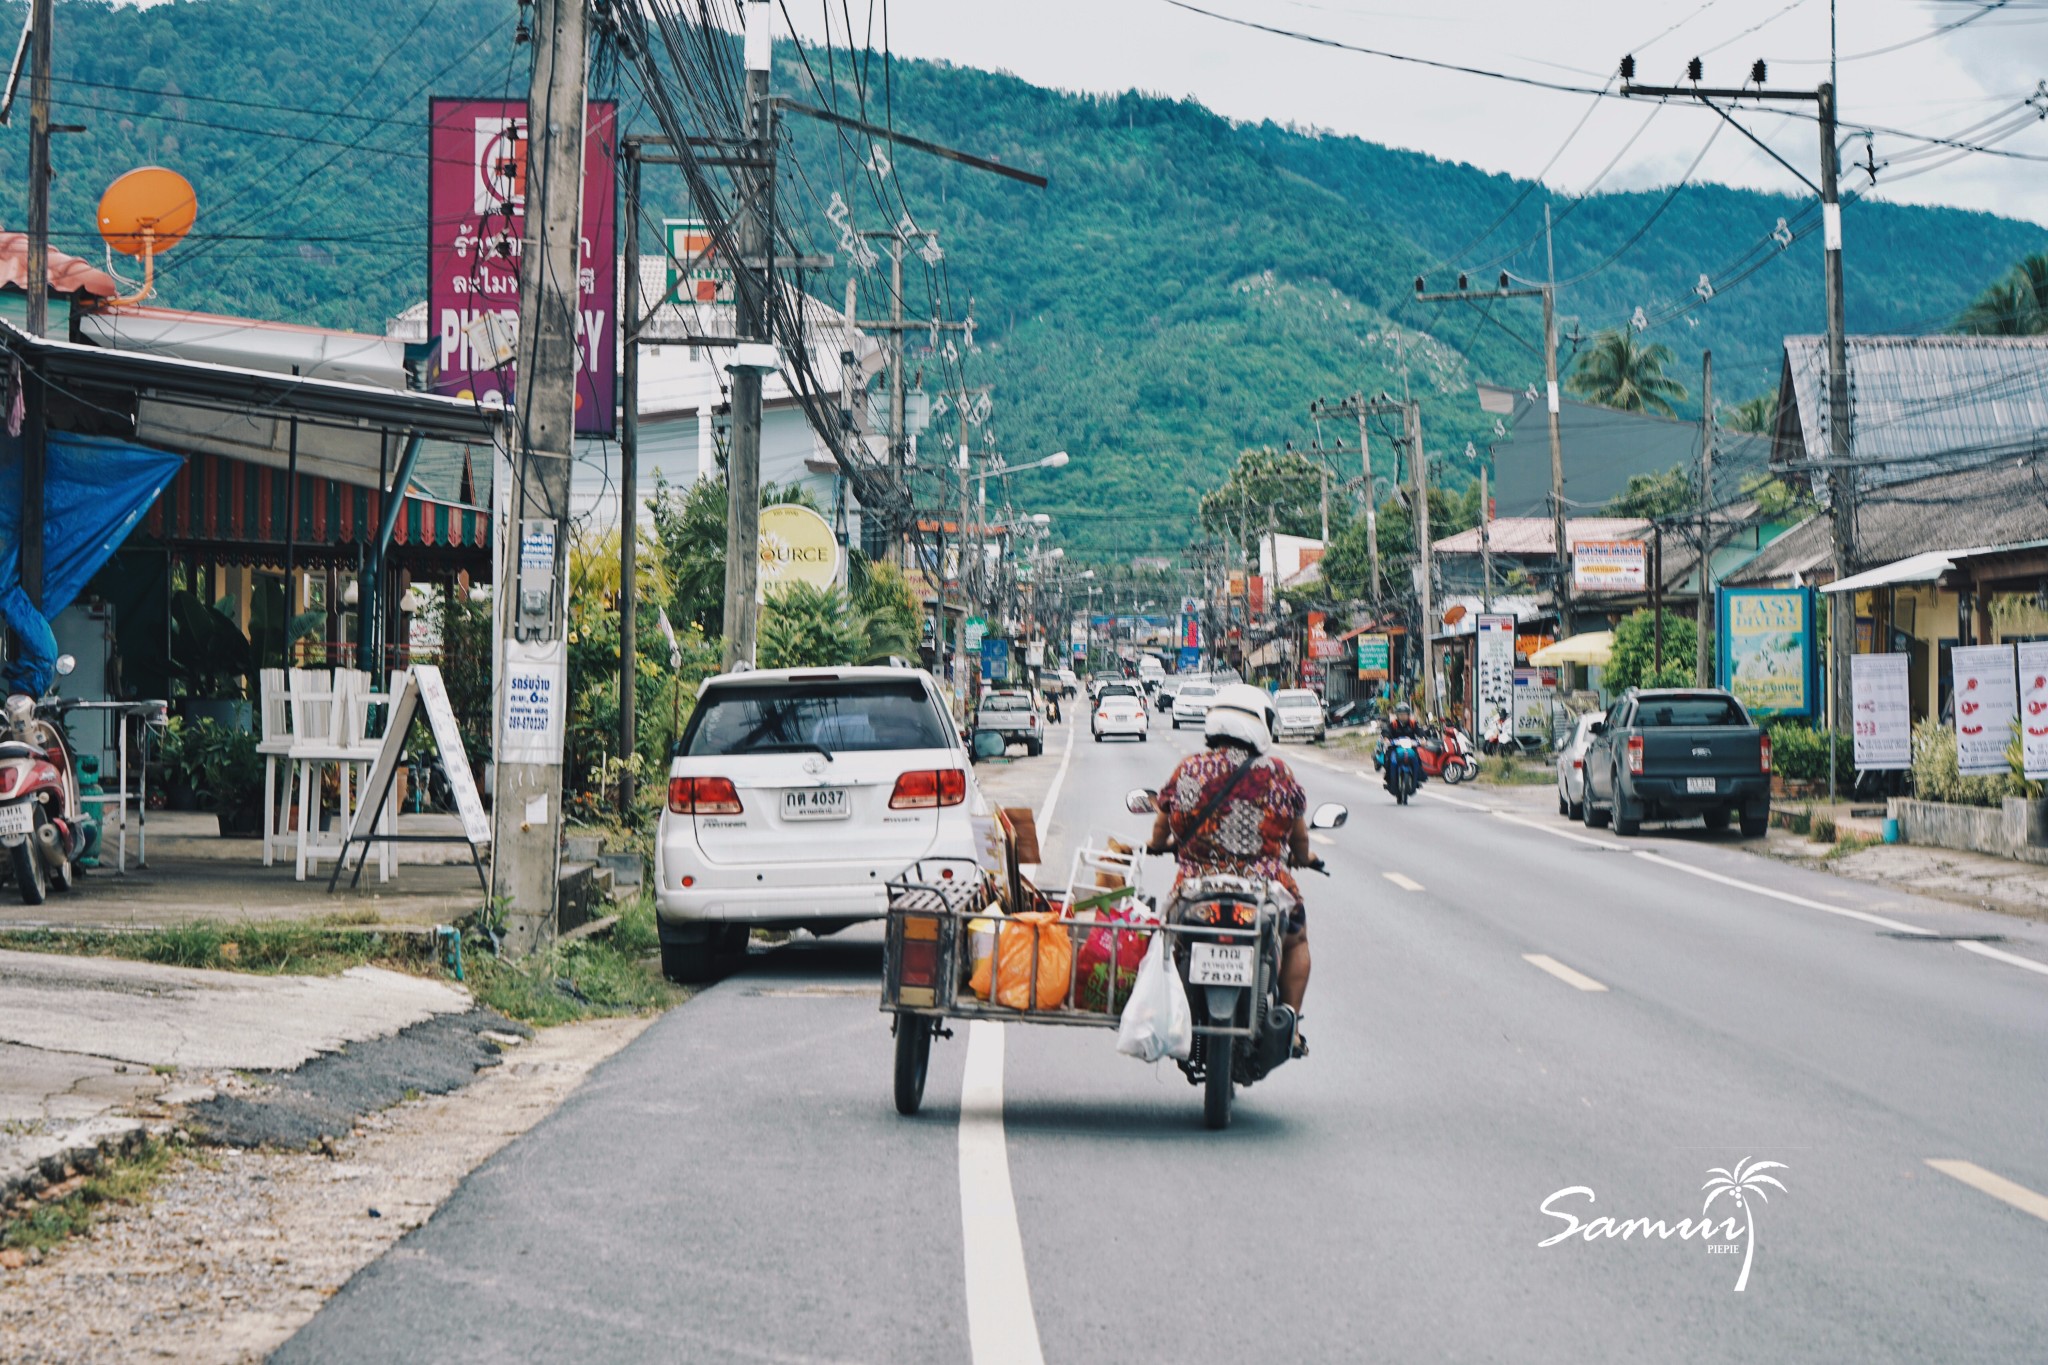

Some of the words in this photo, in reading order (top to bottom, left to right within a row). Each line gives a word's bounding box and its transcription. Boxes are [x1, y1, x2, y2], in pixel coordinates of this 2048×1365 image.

[760, 547, 829, 562] OURCE
[1736, 599, 1799, 614] EASY
[1736, 616, 1798, 627] DIVERS
[811, 790, 844, 806] 4037
